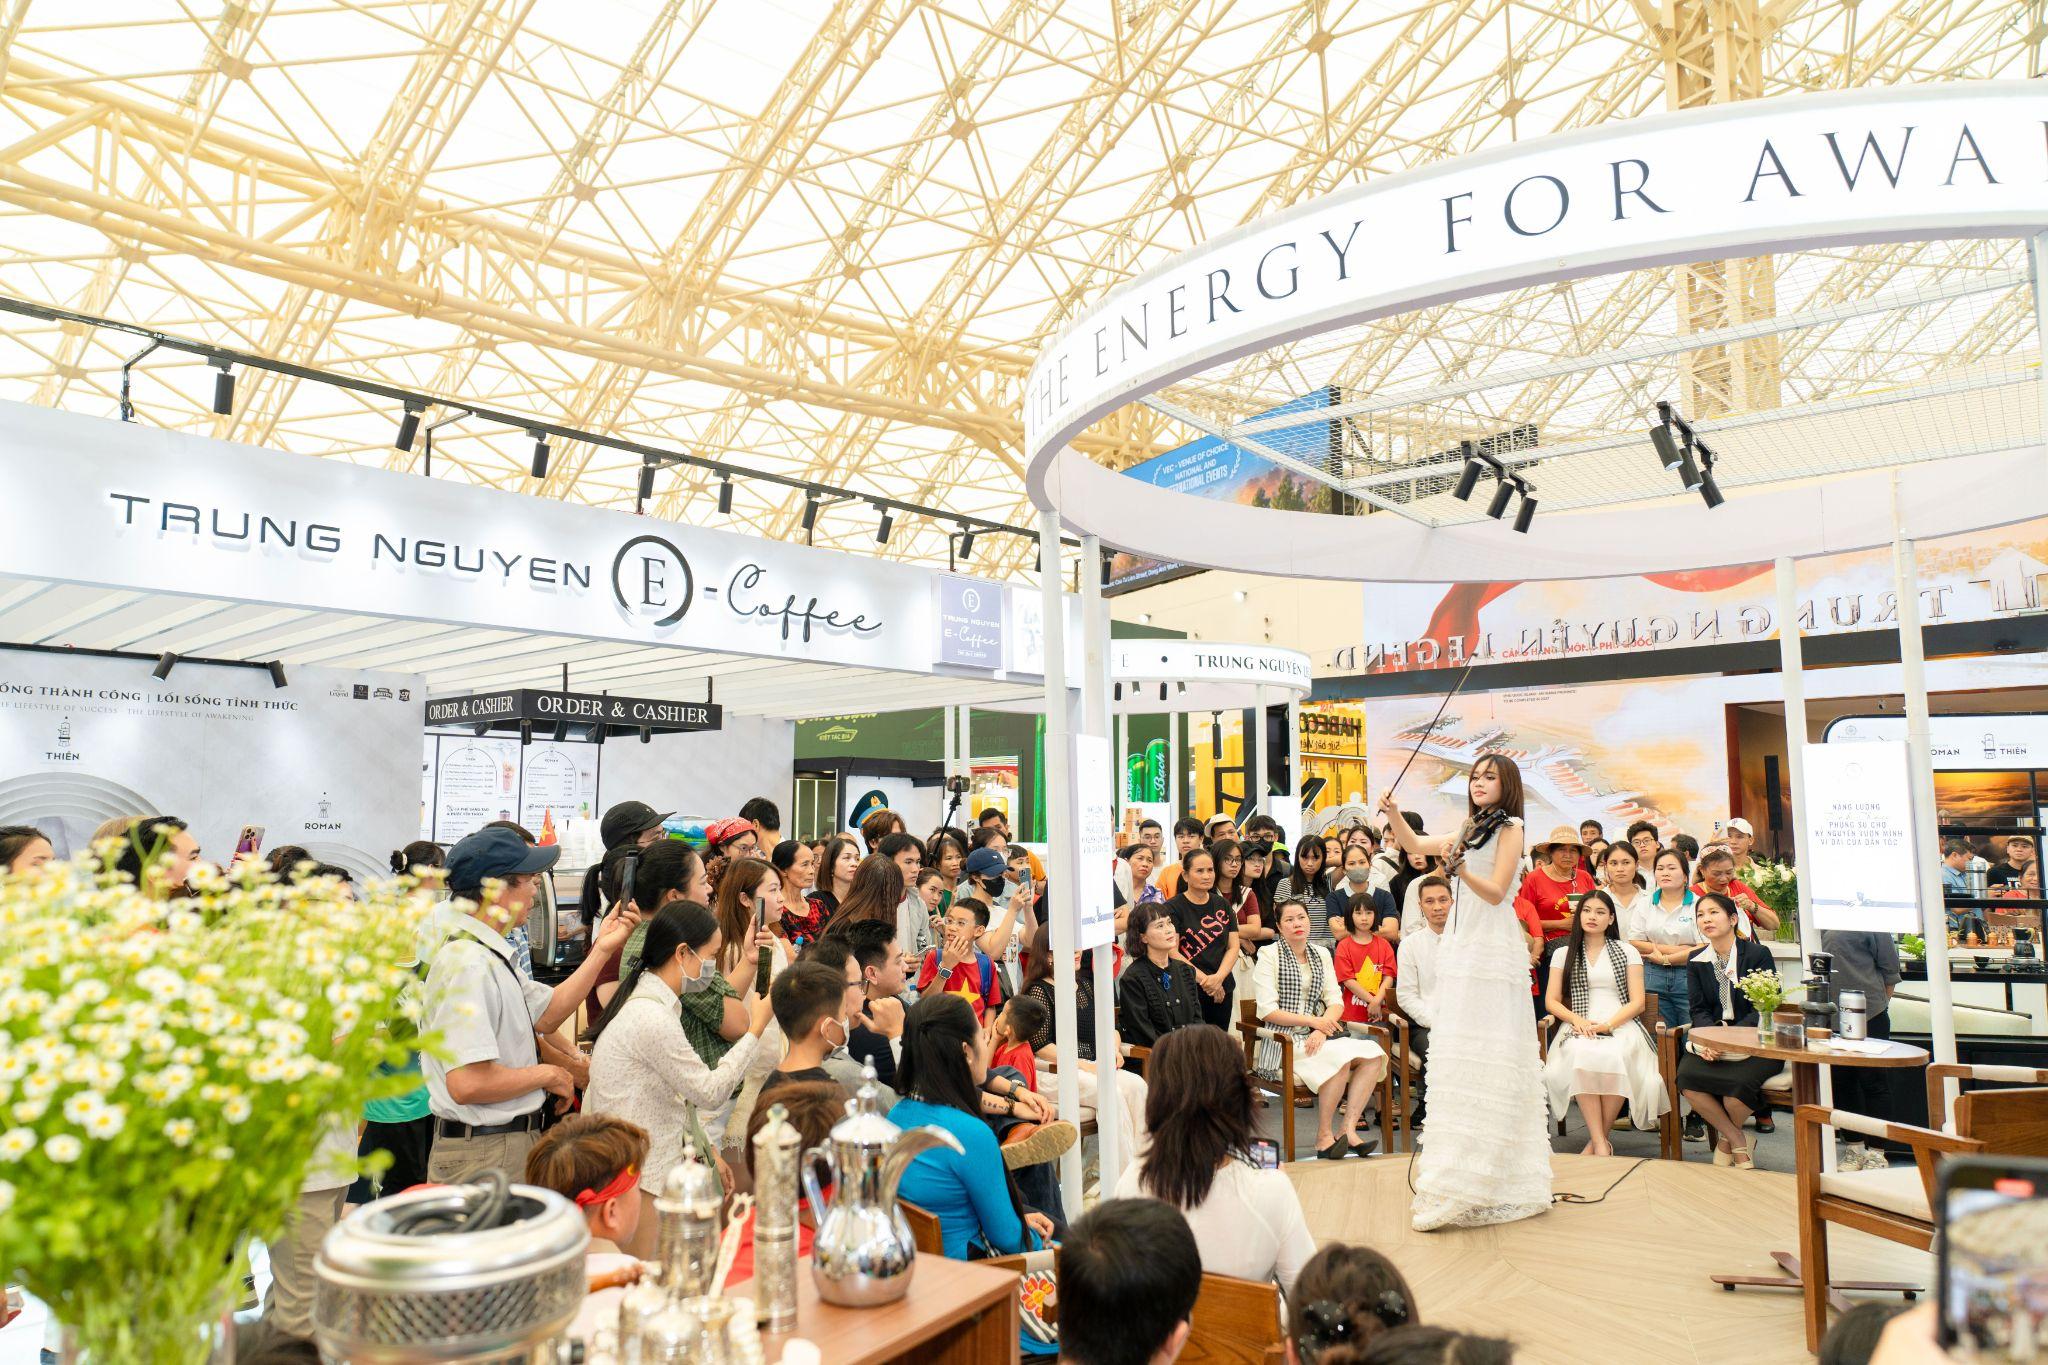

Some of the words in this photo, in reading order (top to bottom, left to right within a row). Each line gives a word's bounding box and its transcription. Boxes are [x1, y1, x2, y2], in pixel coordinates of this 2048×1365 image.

[1031, 354, 1070, 436] THE
[1093, 219, 1365, 378] ENERGY
[1440, 157, 1675, 254] FOR
[1739, 120, 2048, 203] AWA
[1162, 464, 1174, 474] VEC
[1178, 454, 1197, 468] VENUE
[1197, 451, 1206, 461] OF
[1206, 442, 1230, 457] CHOICE
[1174, 465, 1203, 480] NATIONAL
[1204, 458, 1217, 470] AND
[1206, 464, 1228, 484] EVENTS
[109, 493, 341, 552] TRUNG
[373, 533, 591, 588] NGUYEN
[942, 614, 968, 624] TRUNG
[971, 619, 1000, 628] NGUYEN
[1194, 654, 1254, 670] TRUNG
[40, 685, 93, 698] THÀNH
[100, 688, 141, 701] CÔNG
[184, 693, 221, 706] SỐNG
[14, 702, 60, 712] LIFESTYLE
[64, 704, 76, 712] OF
[80, 706, 118, 714] SUCCESS
[127, 708, 144, 716] THE
[148, 709, 188, 718] LIFESTYLE
[205, 713, 254, 722] AWAKENING
[429, 700, 460, 720] ORDER
[461, 700, 469, 716] &
[472, 696, 514, 716] CASHIER
[537, 696, 605, 716] ORDER
[610, 702, 626, 718] &
[632, 702, 710, 724] CASHIER
[1930, 748, 1960, 756] OMAN
[304, 822, 342, 830] ROMAN
